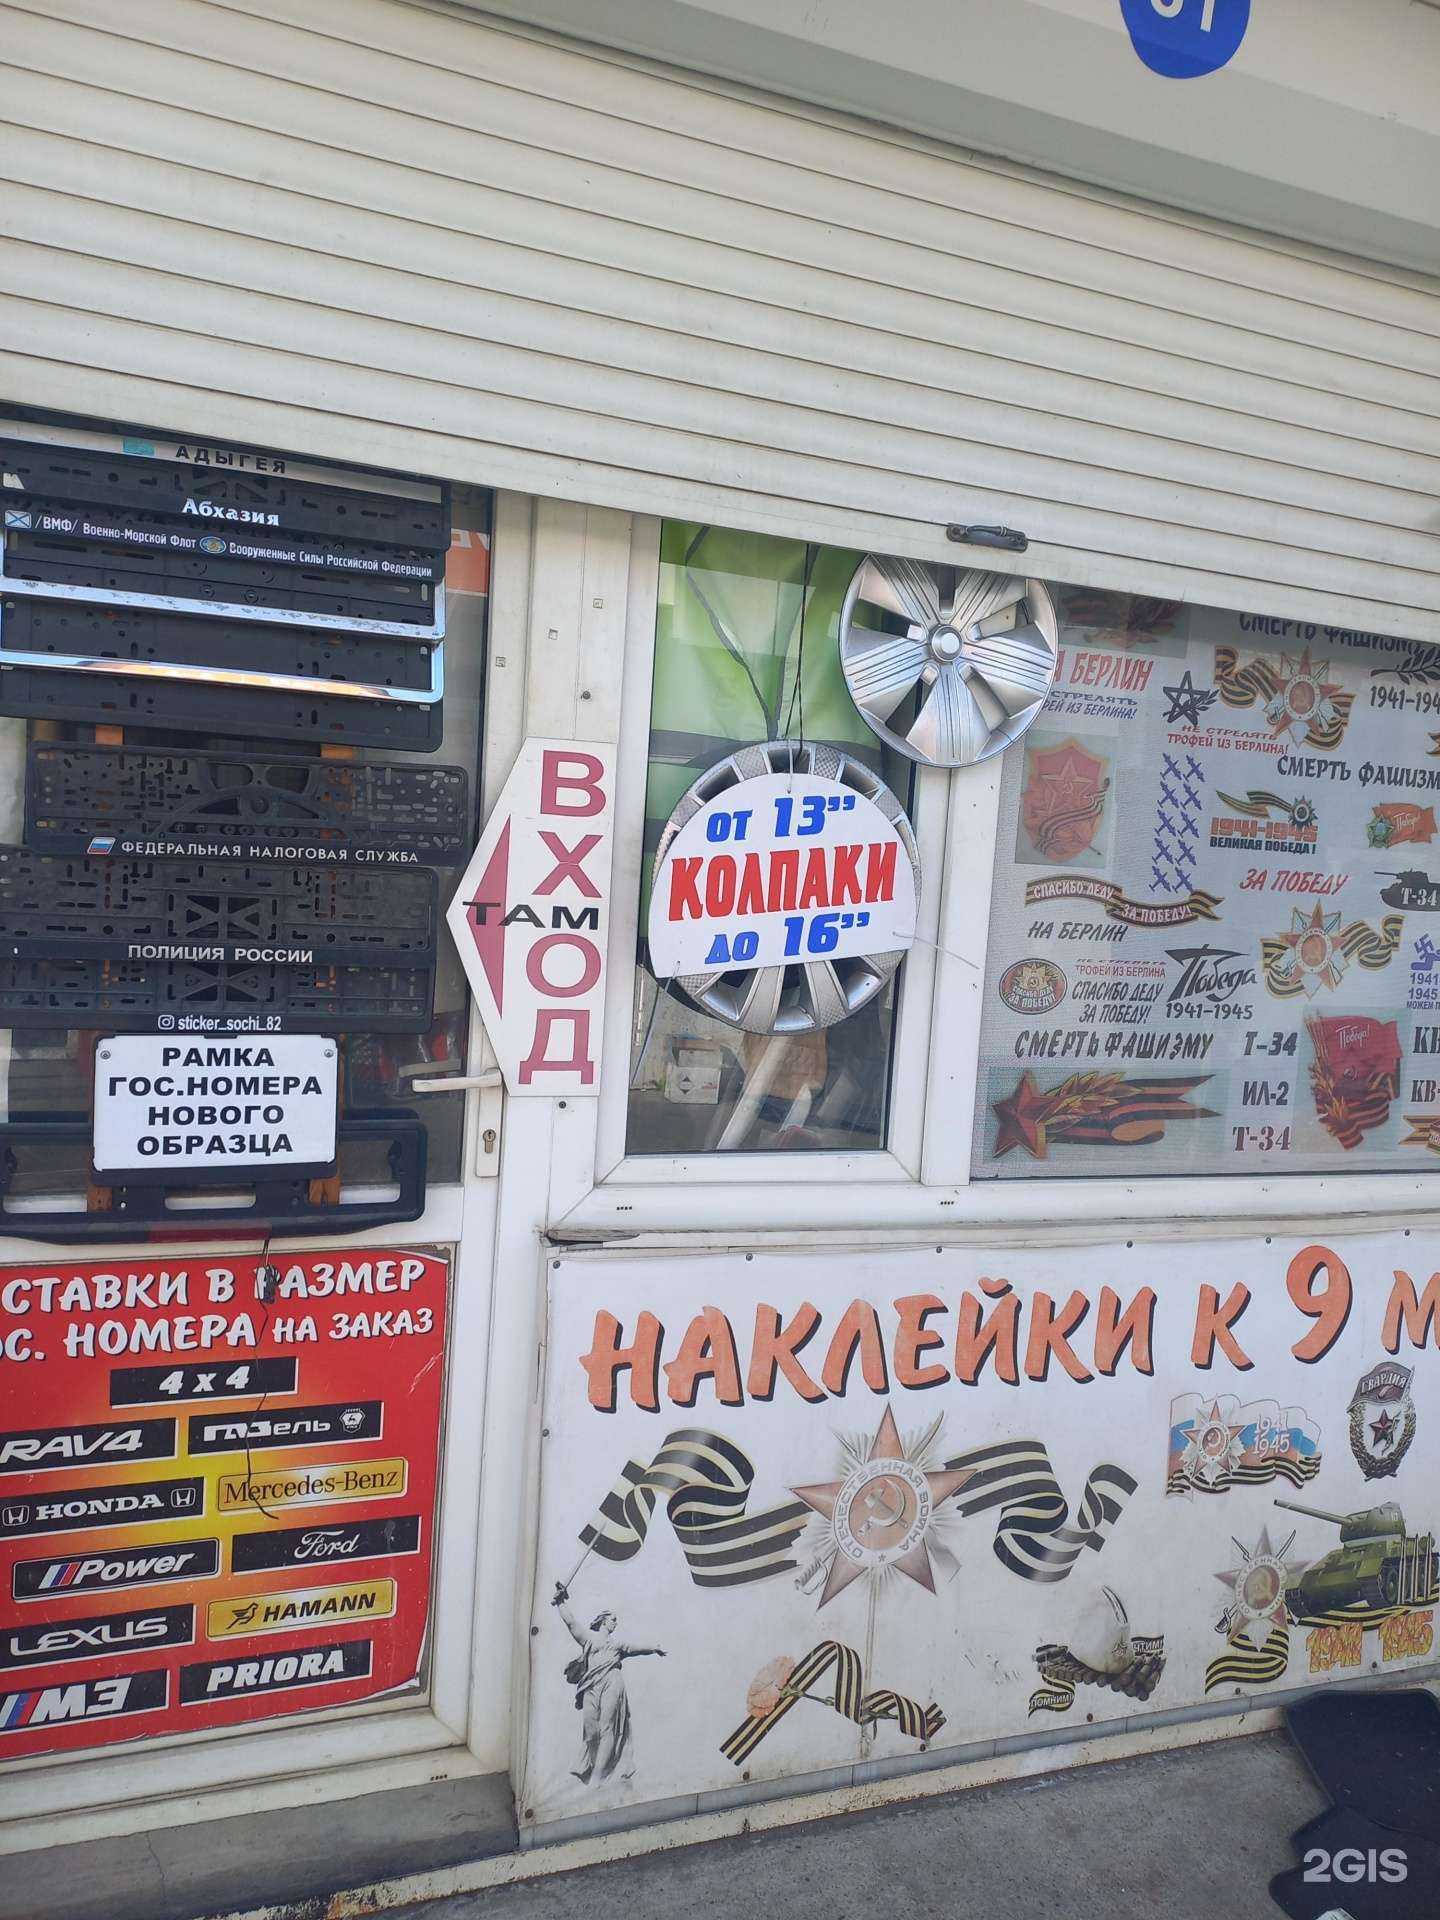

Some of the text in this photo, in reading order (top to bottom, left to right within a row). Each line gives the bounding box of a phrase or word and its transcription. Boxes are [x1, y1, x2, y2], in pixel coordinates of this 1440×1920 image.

[176, 445, 286, 474] АДЫГЕЯ
[182, 498, 280, 527] Абхазия
[83, 525, 167, 545] Военно-Морской
[170, 535, 196, 549] Флот
[229, 542, 432, 577] Вооруженные Силы Российской Федерации
[1070, 652, 1154, 692] БЕРЛИН
[1065, 701, 1082, 714] ИЗ
[1168, 733, 1213, 748] ТРОФЕЙ
[1206, 727, 1278, 741] СТРЕЛЯТЬ
[1277, 755, 1351, 781] СМЕРТЬ
[121, 841, 418, 864] ФЕДЕРАЛЬНАЯ НАЛОГОВАЯ СЛУЖБА
[1210, 836, 1262, 851] ВЕЛИКАЯ
[668, 841, 898, 922] КОЛПАКИ
[1033, 879, 1114, 900] СПАСИБО ДЕДУ
[1240, 868, 1349, 895] ЗА ПОБЕДУ
[1401, 887, 1438, 906] Т-34
[462, 901, 599, 930] ТАМ
[518, 749, 608, 1085] ВХОД
[1121, 902, 1192, 922] ЗА ПОБЕДУ!
[1027, 921, 1129, 942] НА БЕРЛИН
[128, 944, 313, 963] ПОЛИЦИЯ РОССИИ
[1410, 972, 1438, 985] 1941
[1072, 981, 1129, 1001] СПАСИБО
[1129, 983, 1164, 1003] ДЕДУ
[1408, 987, 1437, 1000] 1945
[178, 1015, 281, 1031] sticker_sochi_82
[1079, 1003, 1152, 1024] ЗА ПОБЕДУ!
[1166, 1002, 1253, 1020] 1941-1945
[1014, 1029, 1213, 1060] СМЕРТЬ ФАШИЗМУ
[1243, 1031, 1298, 1056] Т-34
[162, 1047, 275, 1067] РАМКА
[109, 1076, 322, 1097] ГОС.НОМЕРА
[1243, 1080, 1289, 1106] ИЛ-2
[148, 1105, 284, 1126] НОВОГО
[137, 1134, 293, 1156] ОБРАЗЦА
[1232, 1125, 1290, 1151] Т-34
[1, 1271, 188, 1315] СТАВКИ
[206, 1268, 235, 1302] В
[63, 1312, 257, 1357] НОМЕРА
[579, 1276, 1156, 1414] НАКЛЕЙКИ
[1285, 1245, 1354, 1364] 9
[158, 1370, 184, 1395] 4
[226, 1366, 250, 1390] 4
[1361, 1371, 1406, 1394] ГВАРДИЯ
[1255, 1412, 1290, 1434] 1941
[0, 1428, 145, 1463] RAV4
[1253, 1434, 1291, 1458] 1945
[223, 1470, 398, 1505] Mercedes-Benz
[35, 1494, 165, 1521] HONDA
[836, 1461, 924, 1559] ОТЕЧЕСТВЕННАЯ
[294, 1530, 360, 1560] Ford
[263, 1593, 376, 1623] HAMANN
[10, 1616, 168, 1657] LEXUS
[206, 1648, 345, 1692] PRIORA
